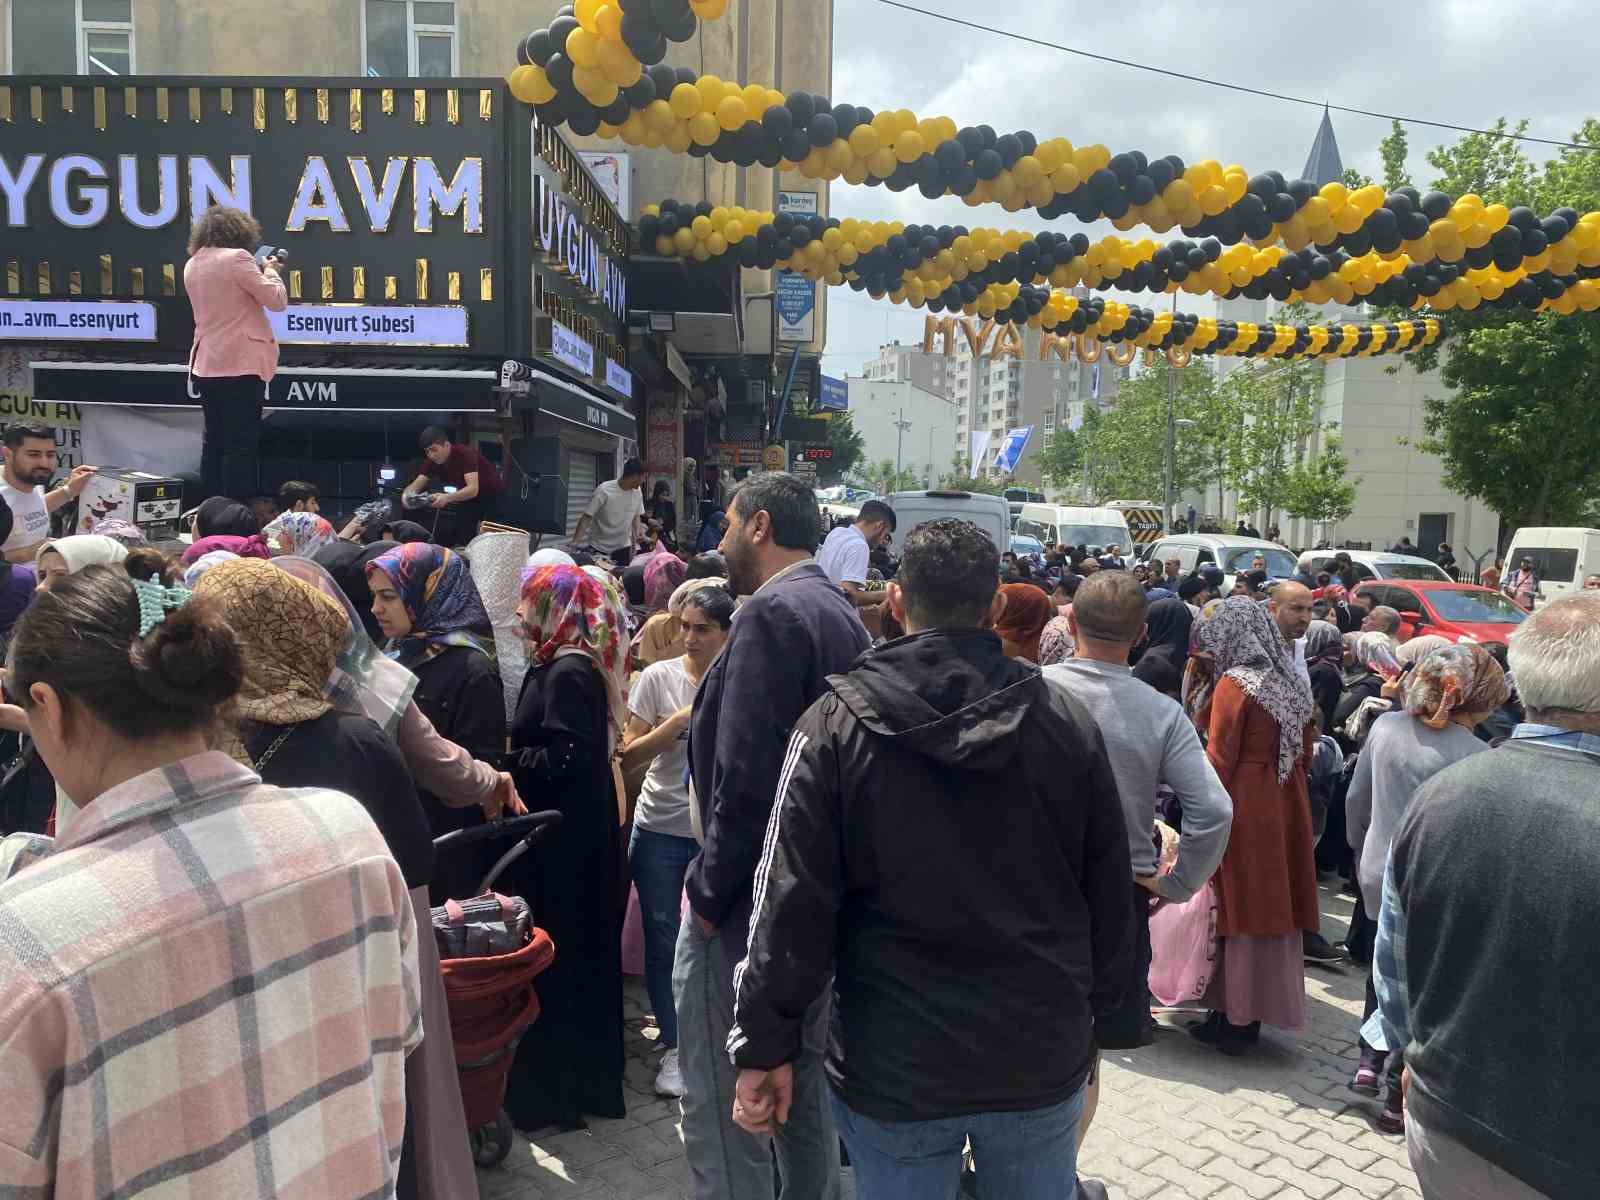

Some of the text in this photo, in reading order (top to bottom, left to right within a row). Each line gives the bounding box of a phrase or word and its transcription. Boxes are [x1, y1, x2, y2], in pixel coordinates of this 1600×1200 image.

[285, 155, 483, 234] AVM
[539, 174, 599, 297] UYGUN
[603, 255, 626, 323] AVM
[0, 311, 140, 331] n_avm_esenyurt
[287, 314, 415, 337] Esenyurt Şubesi
[286, 381, 337, 401] AVM
